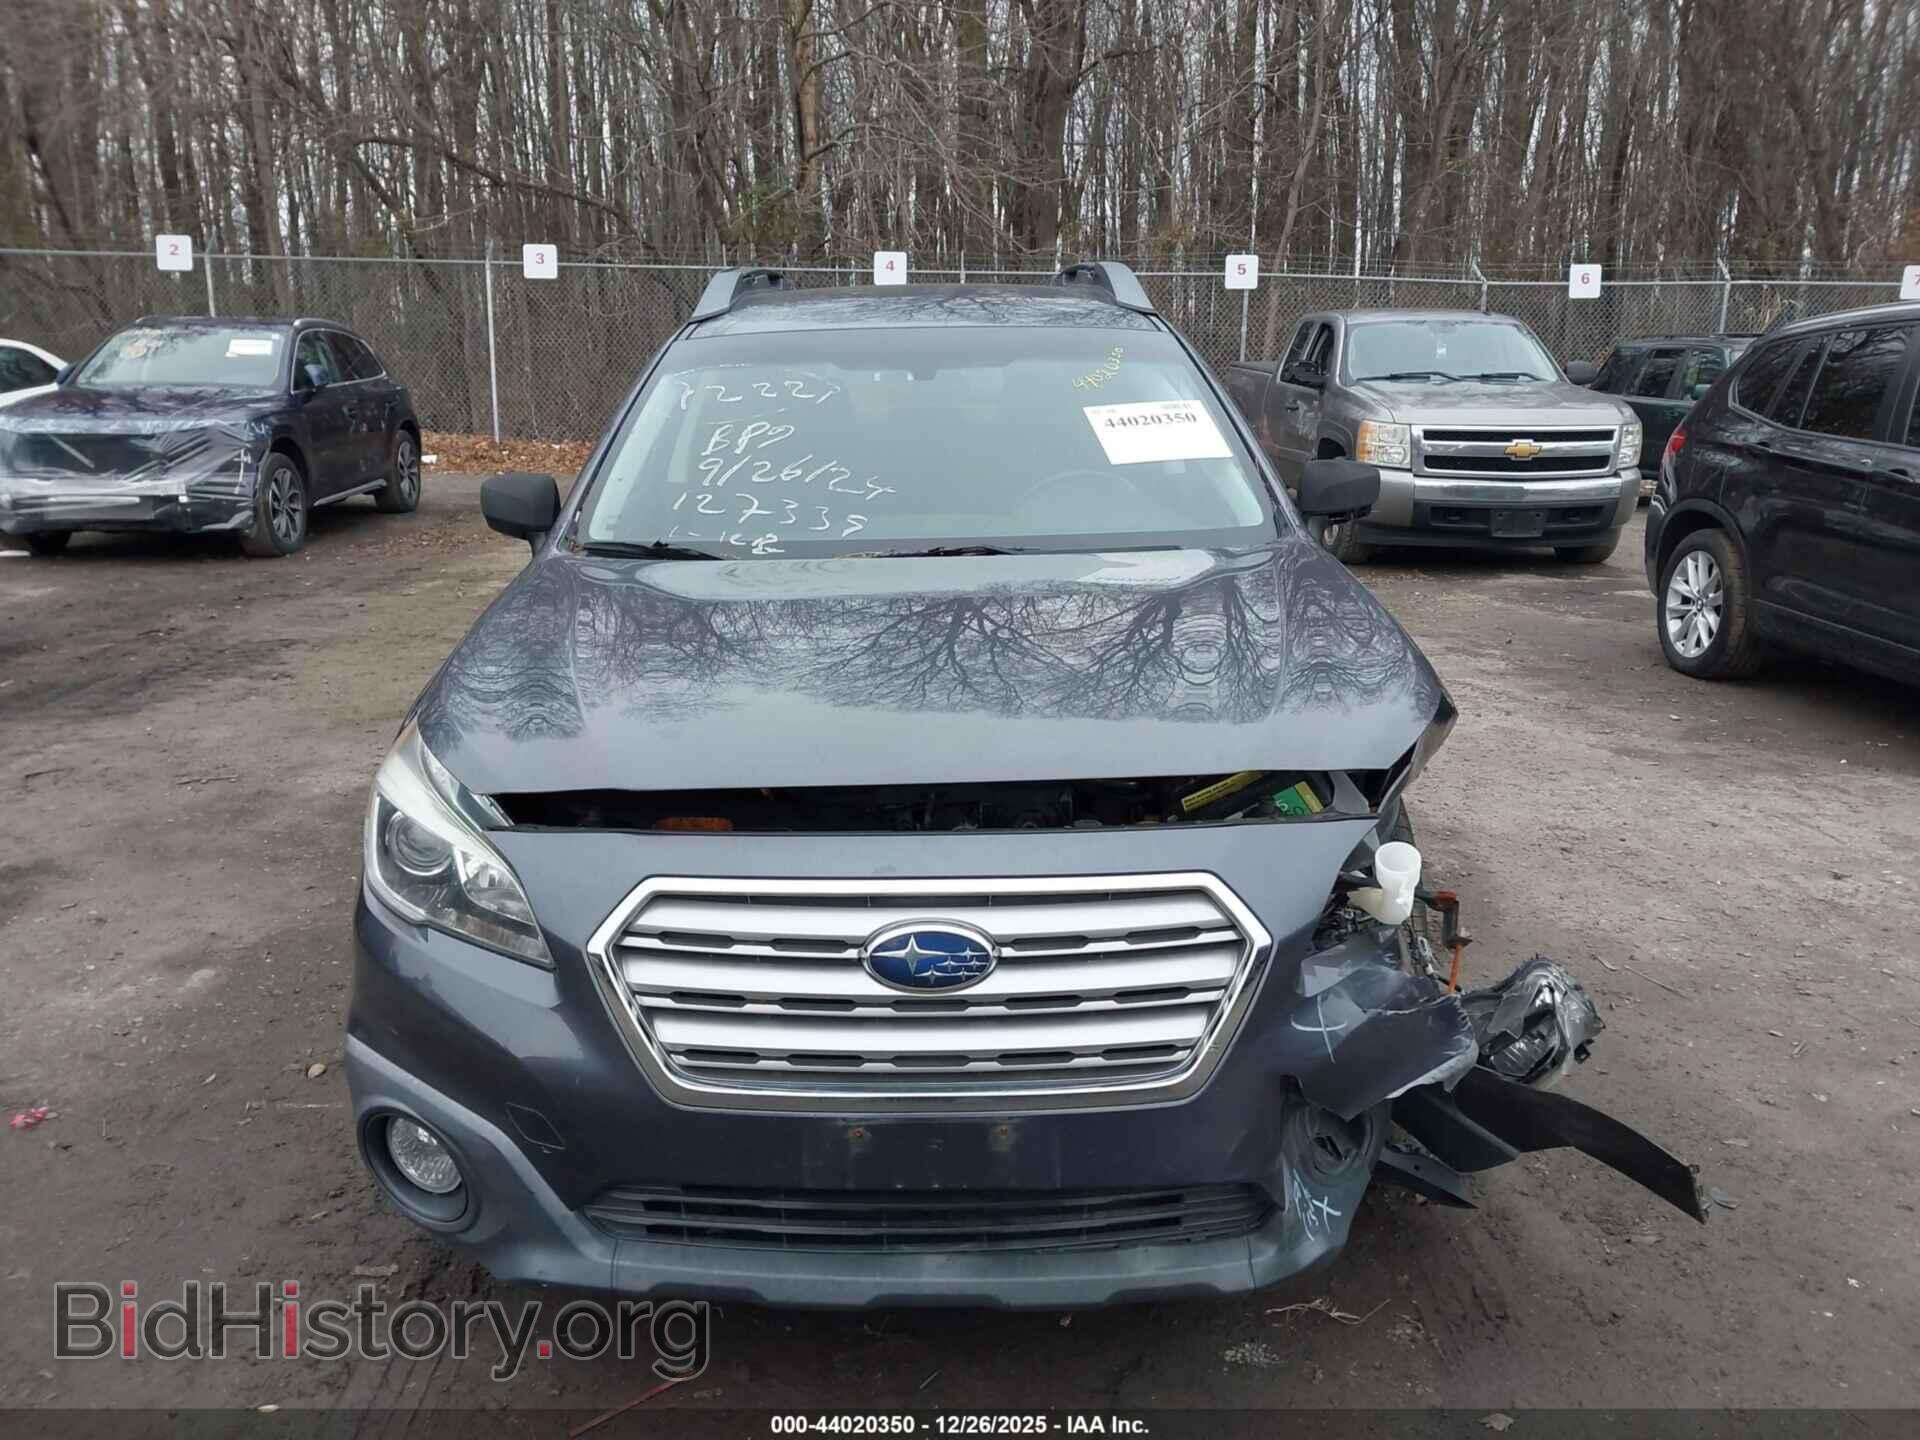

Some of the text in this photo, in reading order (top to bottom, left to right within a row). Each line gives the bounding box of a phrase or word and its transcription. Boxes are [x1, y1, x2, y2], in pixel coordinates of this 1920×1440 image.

[169, 244, 180, 256] 2
[535, 252, 545, 264] 3
[885, 260, 895, 271] 4
[1237, 263, 1247, 275] 5
[1581, 273, 1591, 284] 6
[1104, 412, 1198, 429] 44020350
